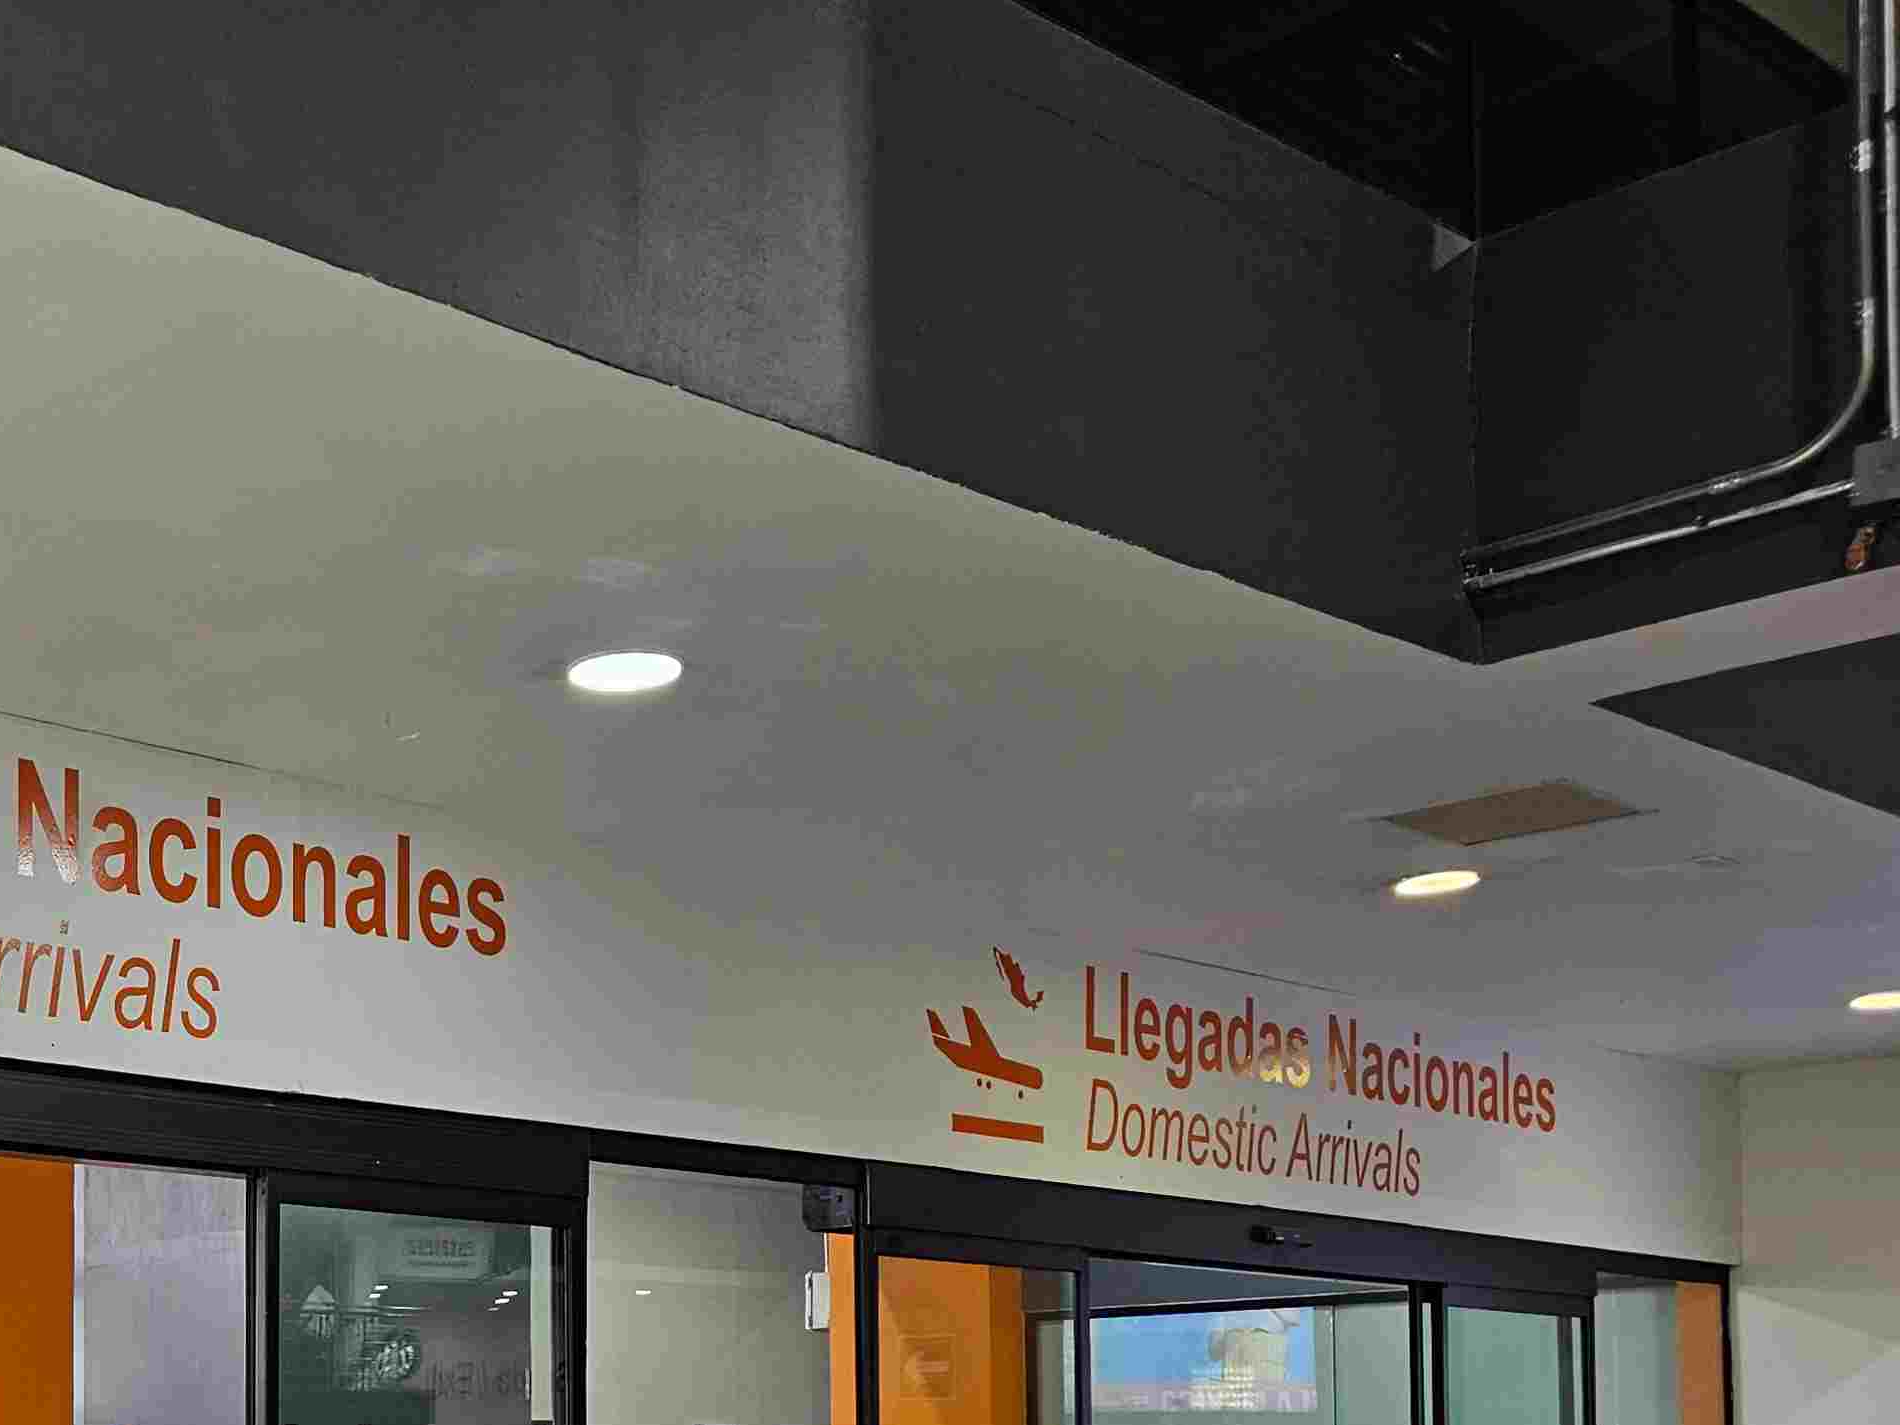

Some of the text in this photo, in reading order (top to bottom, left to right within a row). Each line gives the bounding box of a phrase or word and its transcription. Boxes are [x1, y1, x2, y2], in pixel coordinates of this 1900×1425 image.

[15, 756, 508, 958] Nacionales
[1082, 965, 1557, 1133] Llegadas Nacionales
[1084, 1077, 1422, 1198] Domestic Arrivals
